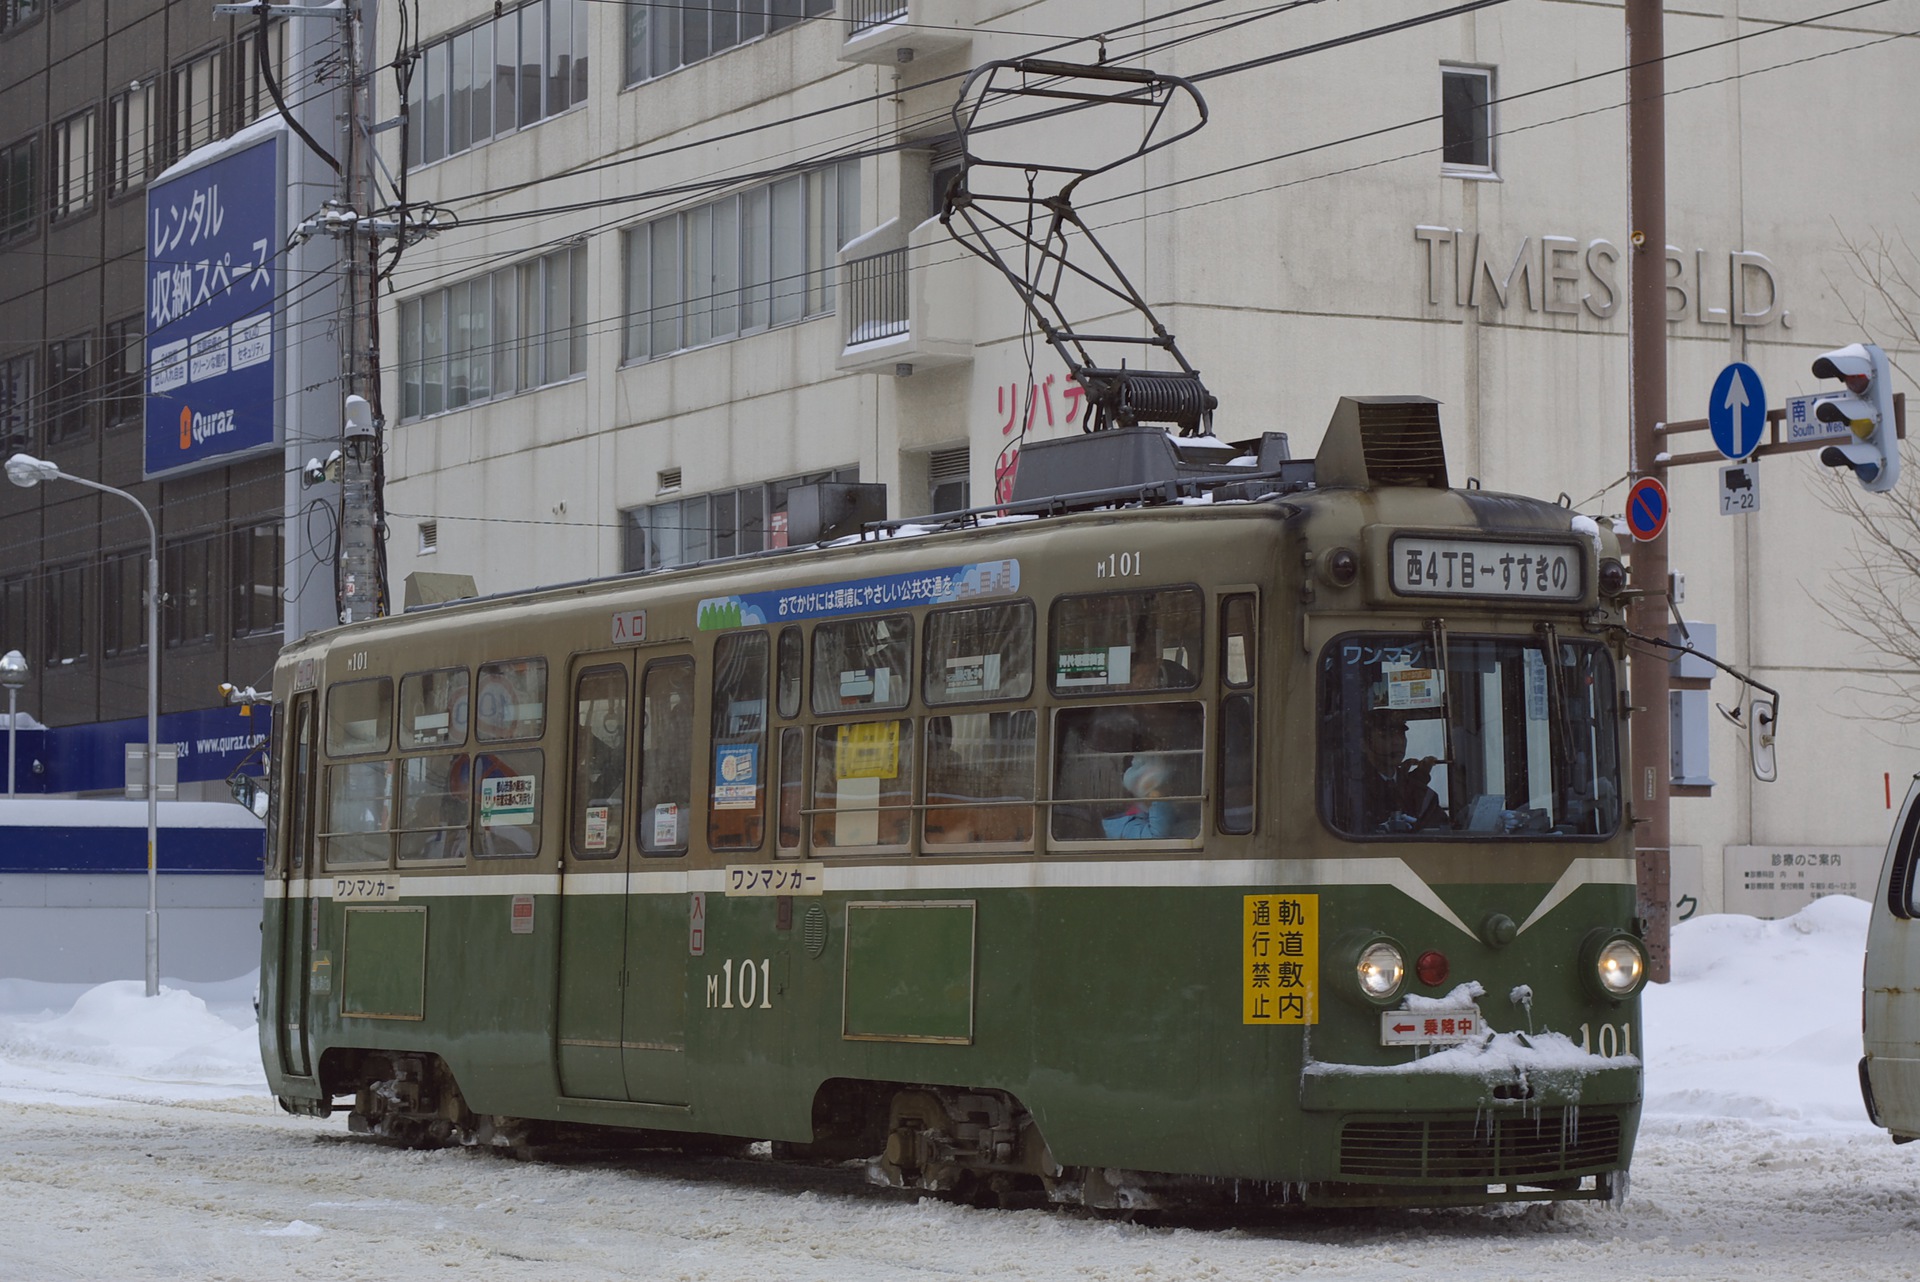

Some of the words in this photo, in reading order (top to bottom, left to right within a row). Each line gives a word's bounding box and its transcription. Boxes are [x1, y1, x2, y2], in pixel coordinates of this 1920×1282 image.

[154, 184, 224, 257] レンタル
[151, 238, 270, 327] 収納スペース
[1415, 225, 1621, 319] TIMES
[193, 408, 235, 444] Quraz
[1792, 423, 1814, 437] South
[1724, 493, 1754, 511] 7-22
[1097, 551, 1141, 578] M101
[1406, 549, 1474, 588] 西4丁目
[1499, 552, 1568, 592] すすきの
[615, 615, 643, 640] 入口
[347, 651, 368, 671] M101
[1343, 645, 1422, 666] ワンマン
[1771, 853, 1842, 867] 診療のご案内
[337, 879, 396, 897] ワンマンカー
[732, 868, 817, 890] ワンマンカー
[691, 896, 704, 952] 入口
[1251, 898, 1272, 1020] 通行禁止
[1277, 898, 1305, 1020] 軌道敷内
[706, 958, 773, 1009] M101
[1423, 1017, 1473, 1036] 乗降中
[1579, 1022, 1631, 1059] 101
